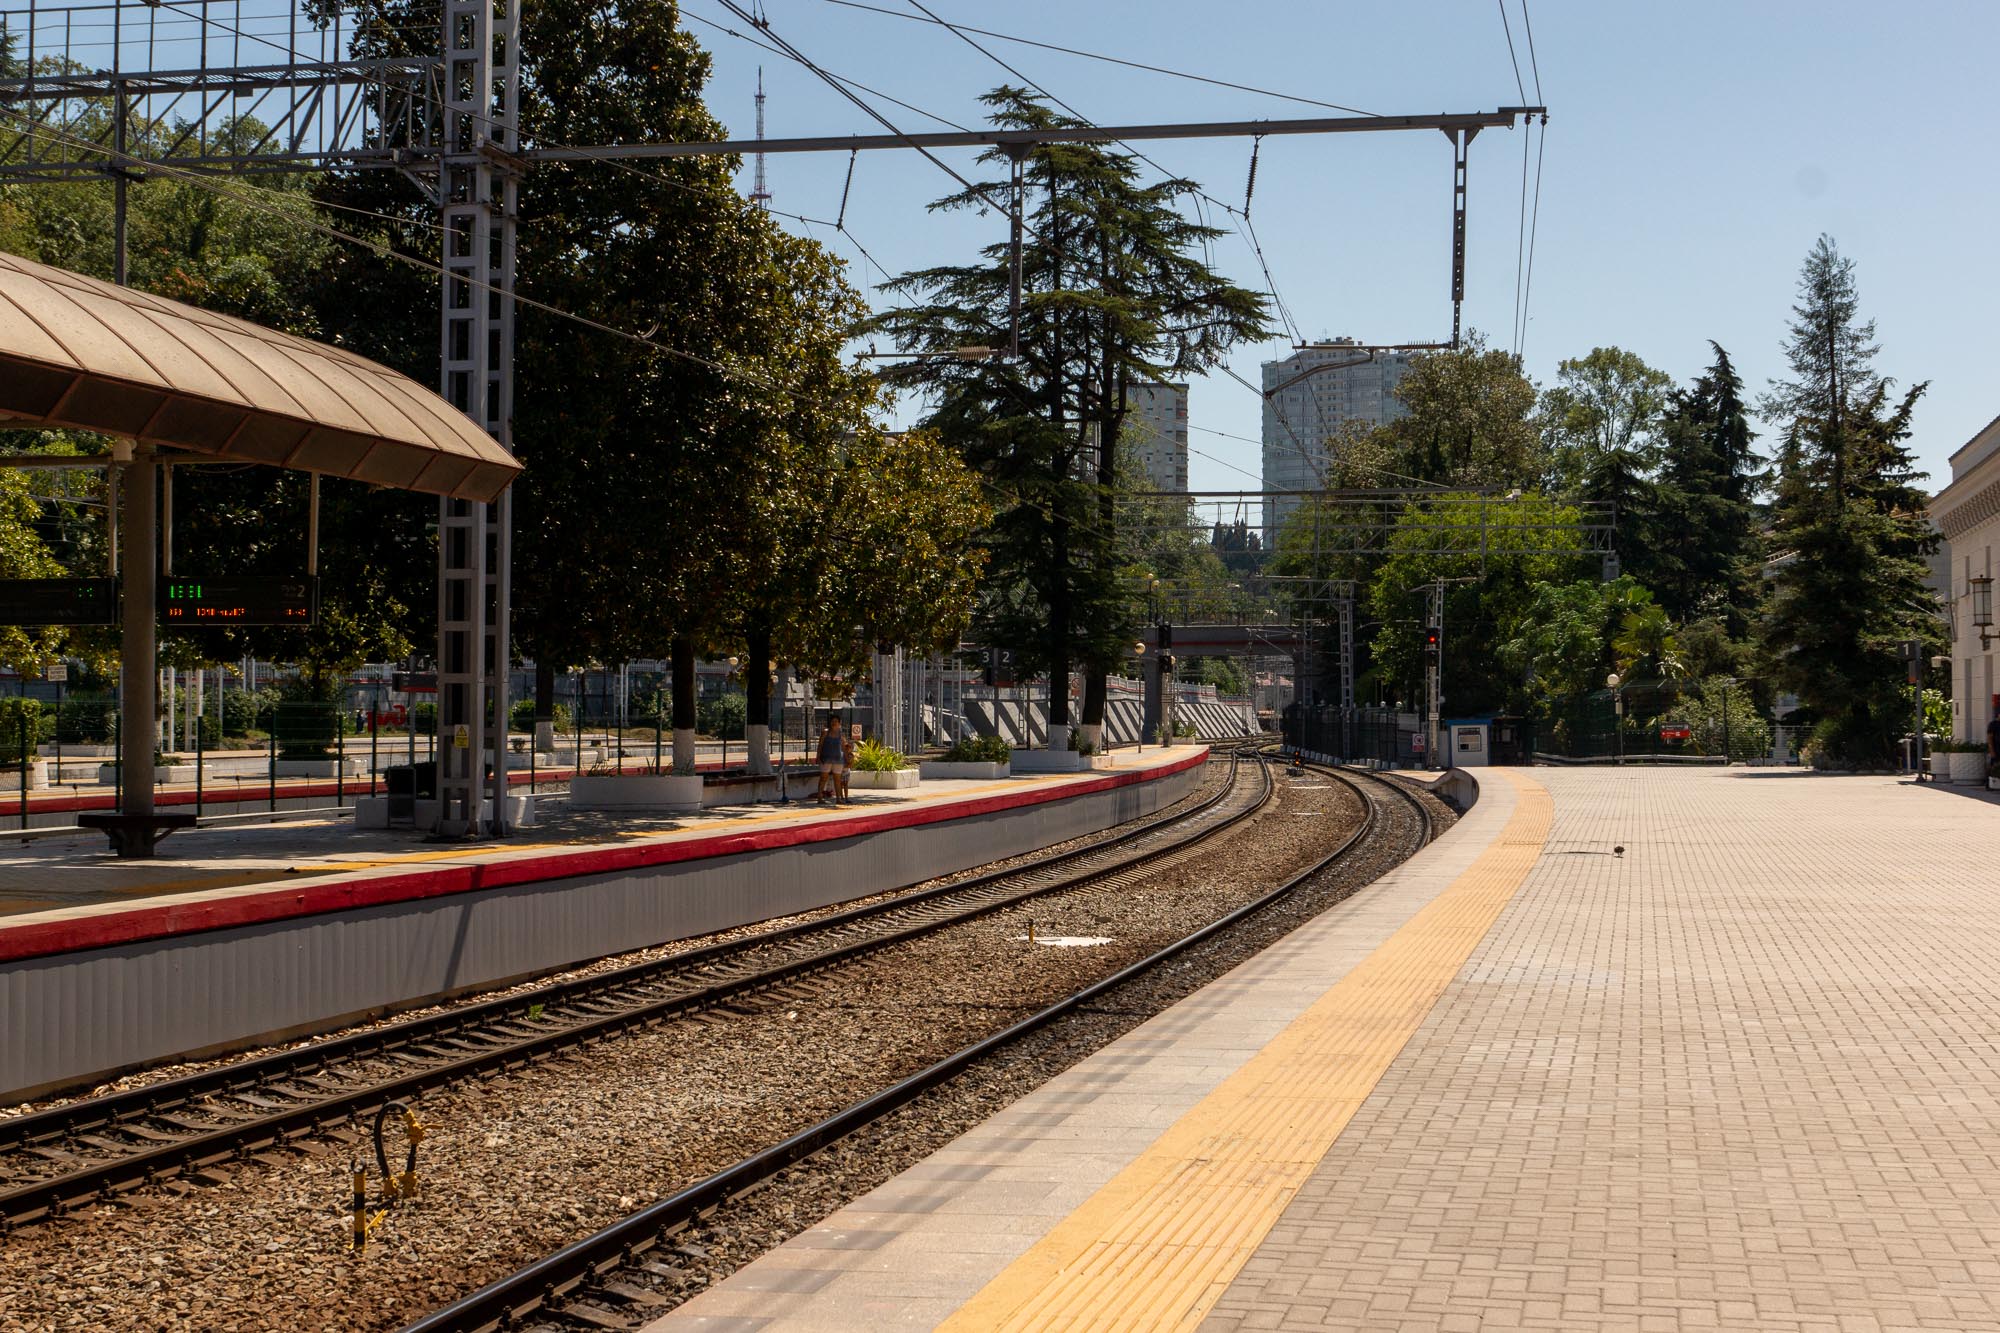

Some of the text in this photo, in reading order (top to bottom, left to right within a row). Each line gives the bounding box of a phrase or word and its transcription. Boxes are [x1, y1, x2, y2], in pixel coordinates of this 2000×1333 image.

[1903, 643, 1909, 656] 1
[417, 657, 425, 669] 4
[982, 651, 990, 663] 3
[1002, 651, 1010, 663] 2
[400, 659, 407, 669] 5
